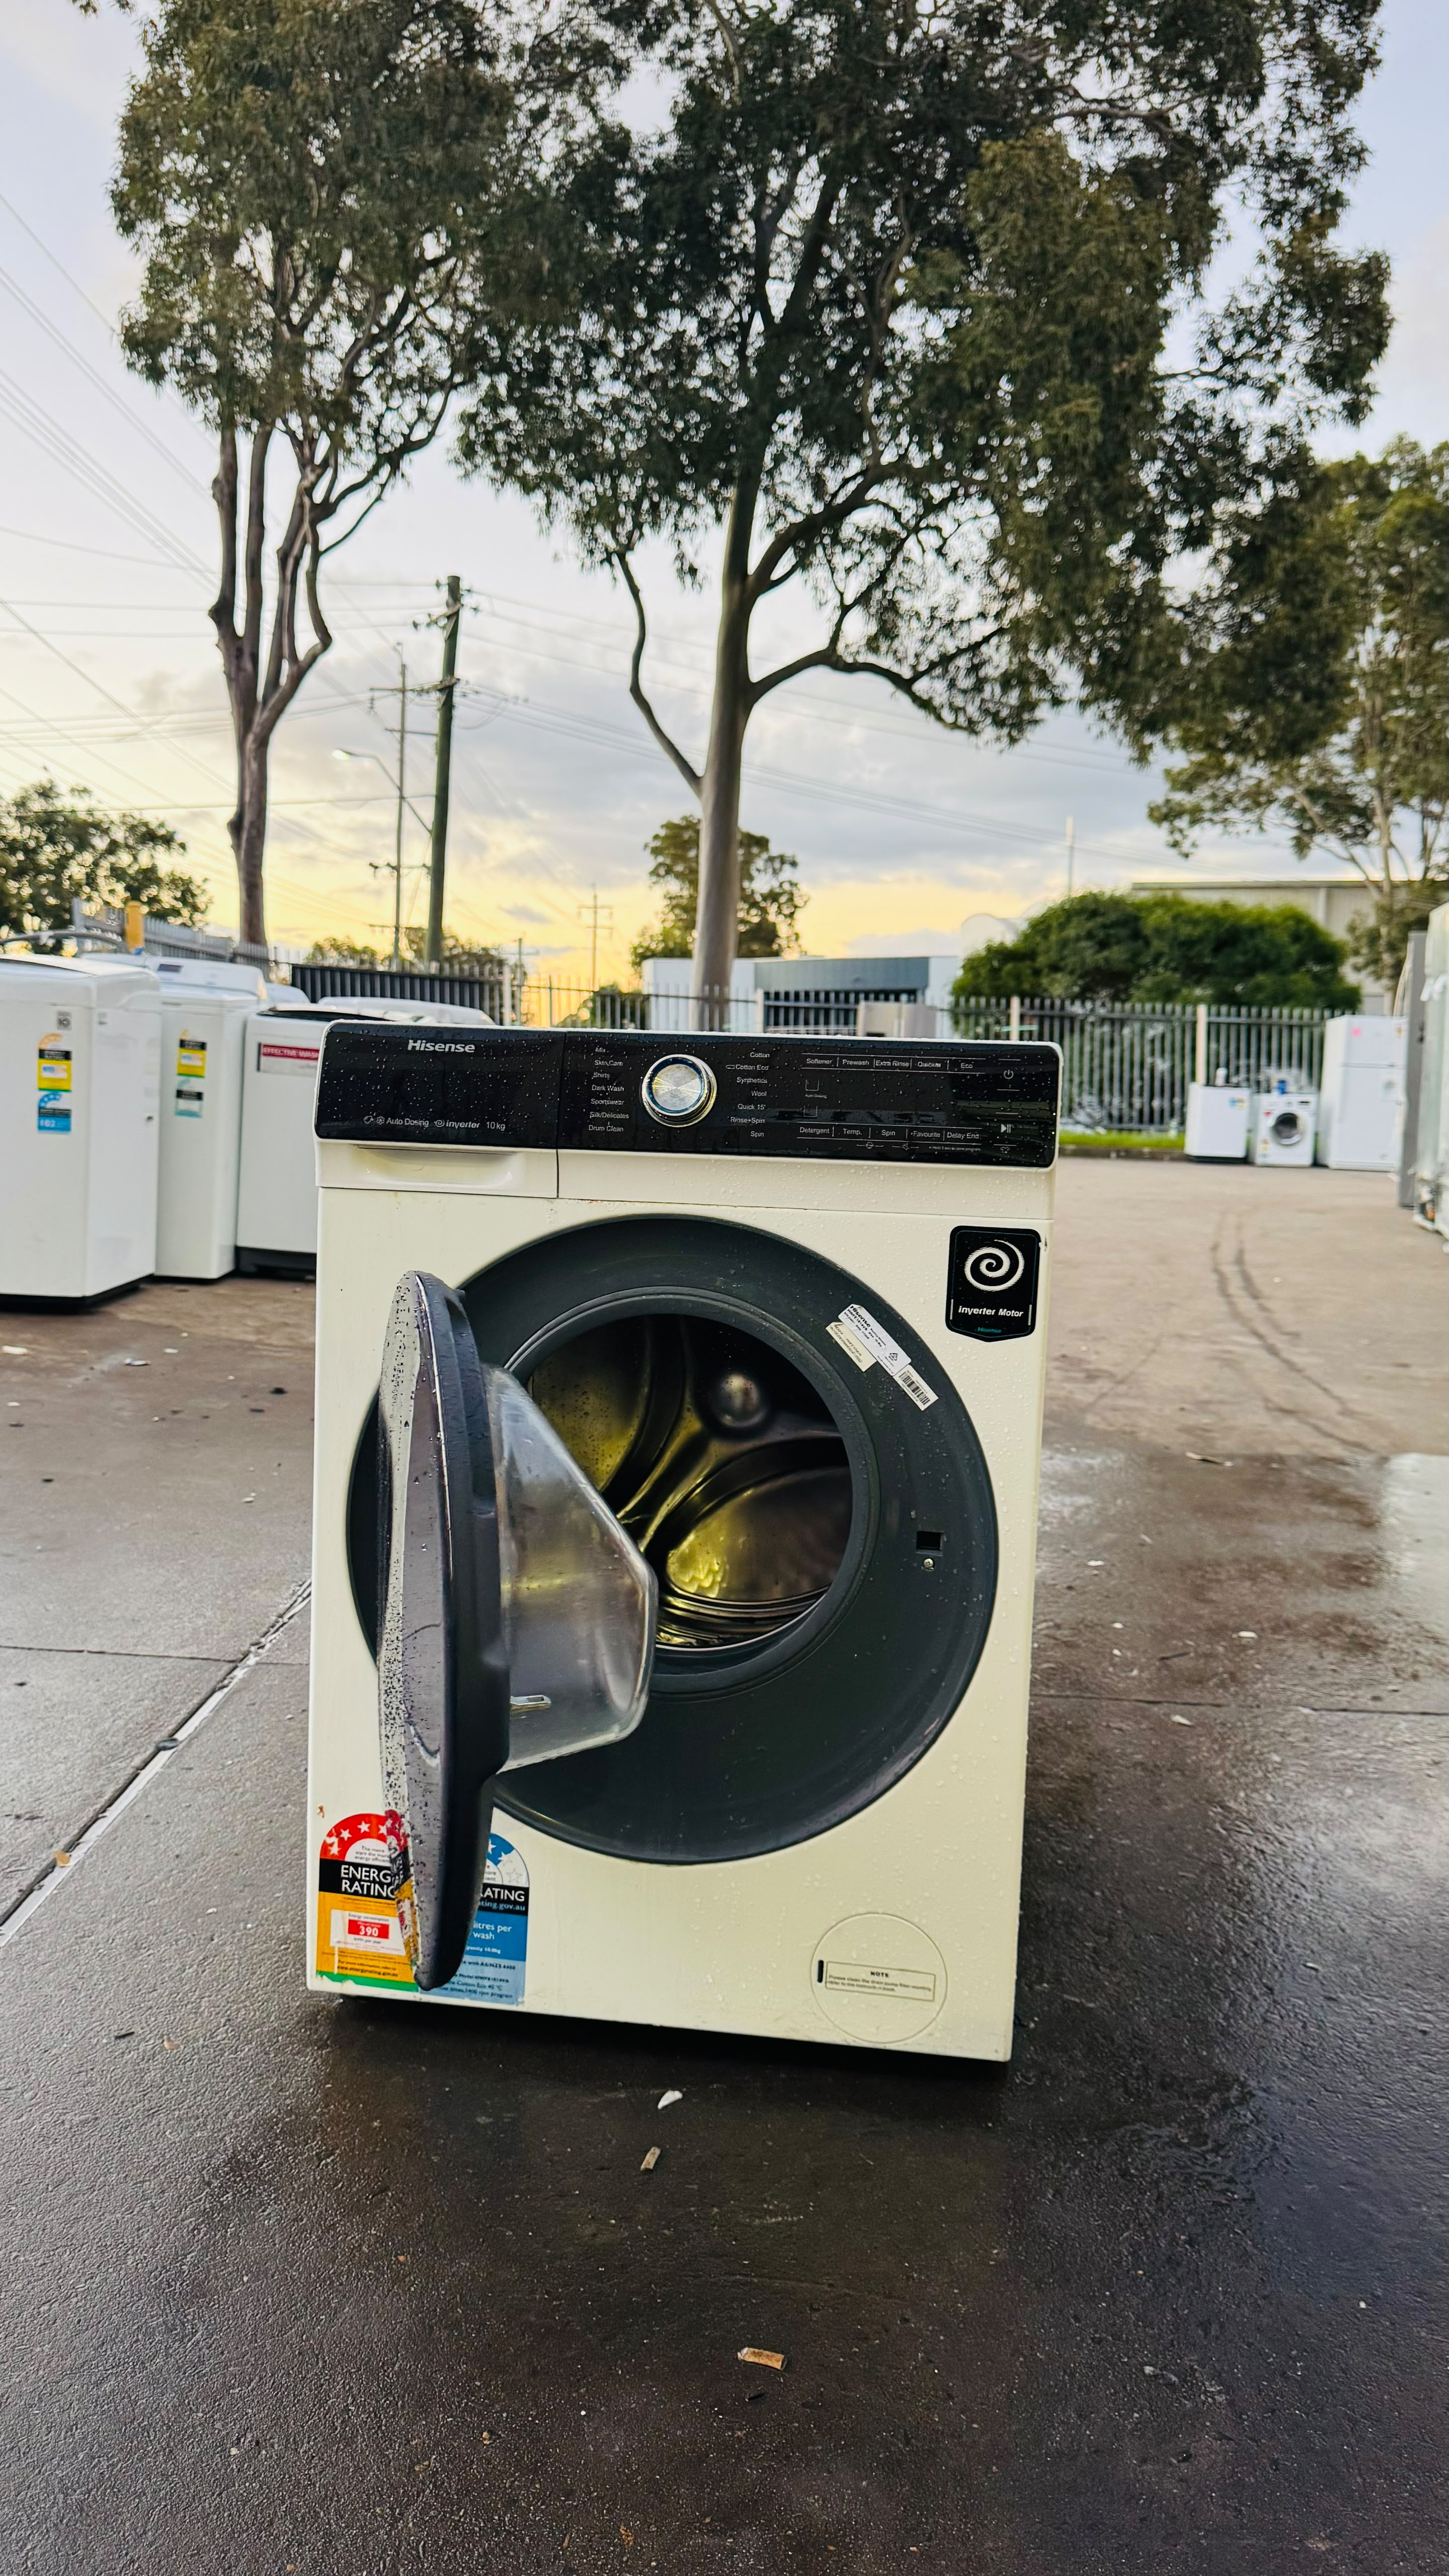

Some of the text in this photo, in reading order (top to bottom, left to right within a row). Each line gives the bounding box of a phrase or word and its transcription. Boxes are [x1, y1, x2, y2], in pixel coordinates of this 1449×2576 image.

[408, 1040, 475, 1053] Hisense
[405, 1118, 429, 1128] Dosing
[446, 1121, 480, 1130] inverter
[800, 1126, 829, 1135] Detergent
[850, 1305, 871, 1328] Hisense
[958, 1306, 1024, 1317] inverter Motor
[341, 1865, 391, 1883] ENERG
[480, 1887, 525, 1902] ATING
[359, 1925, 378, 1937] 390
[497, 1925, 512, 1933] per
[473, 1931, 495, 1940] wash
